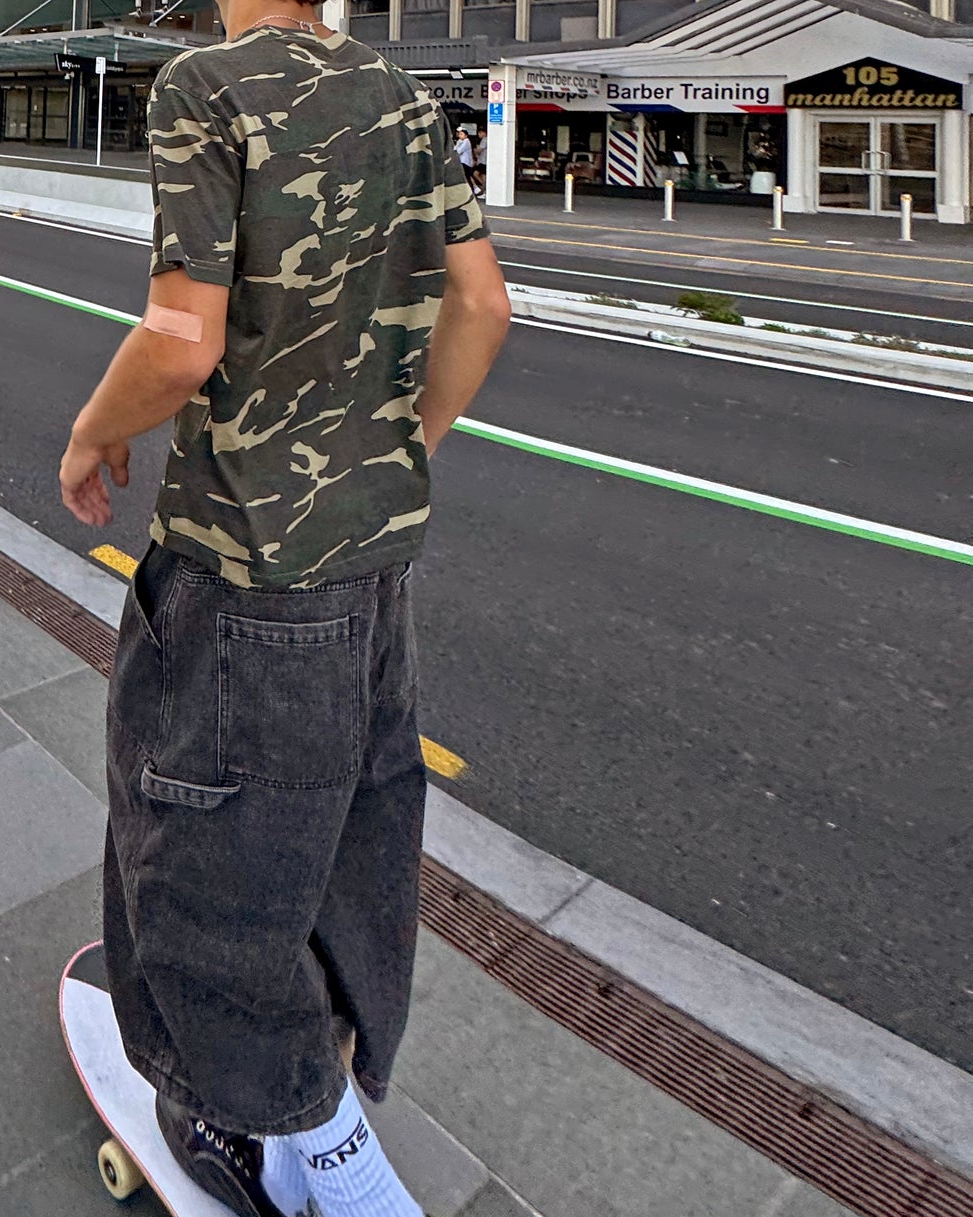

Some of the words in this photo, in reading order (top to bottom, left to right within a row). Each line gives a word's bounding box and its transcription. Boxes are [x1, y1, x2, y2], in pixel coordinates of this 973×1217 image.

[527, 70, 598, 88] mrbarber.co.nz
[842, 66, 900, 86] 105
[607, 84, 674, 99] Barber
[679, 84, 770, 104] Training
[787, 87, 959, 107] manhattan
[299, 1116, 369, 1171] VANS
